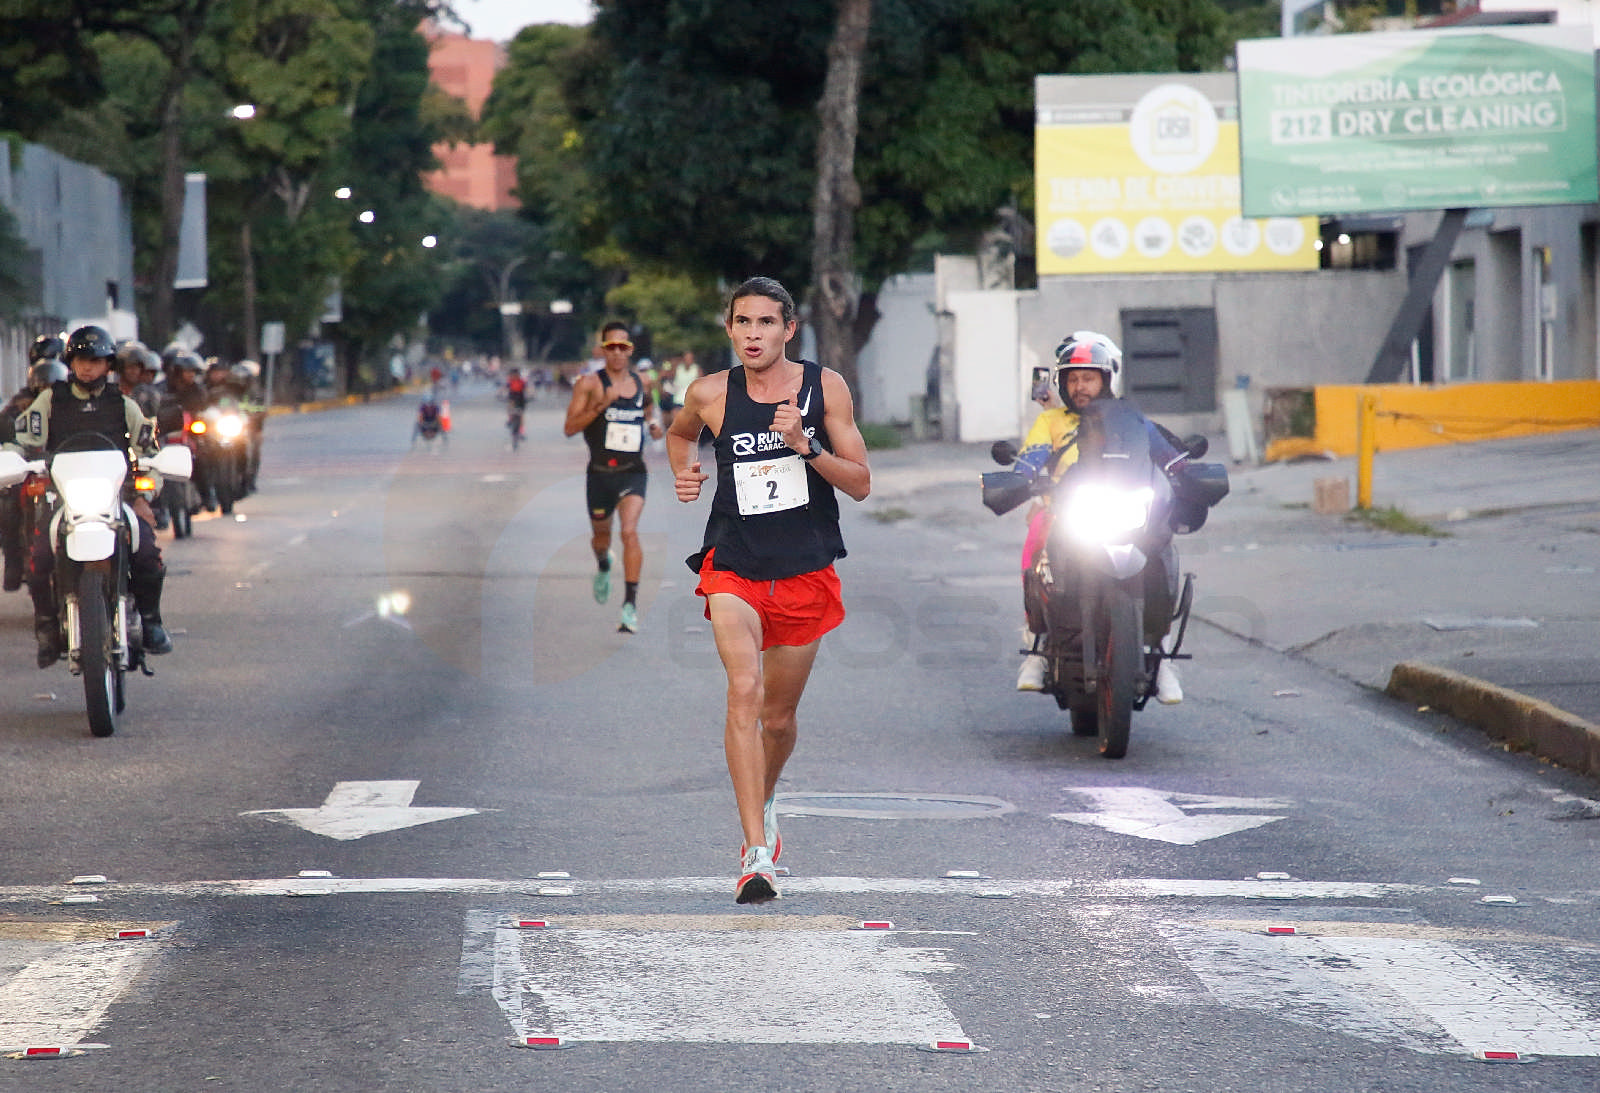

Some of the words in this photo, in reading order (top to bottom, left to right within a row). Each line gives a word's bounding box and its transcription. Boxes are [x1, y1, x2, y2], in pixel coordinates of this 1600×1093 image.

[1272, 78, 1411, 105] TINTORERÍA
[1418, 68, 1562, 99] ECOLÓGICA
[1279, 114, 1323, 138] 212
[1338, 110, 1395, 137] DRY
[1403, 101, 1557, 133] CLEANING
[766, 480, 779, 500] 2
